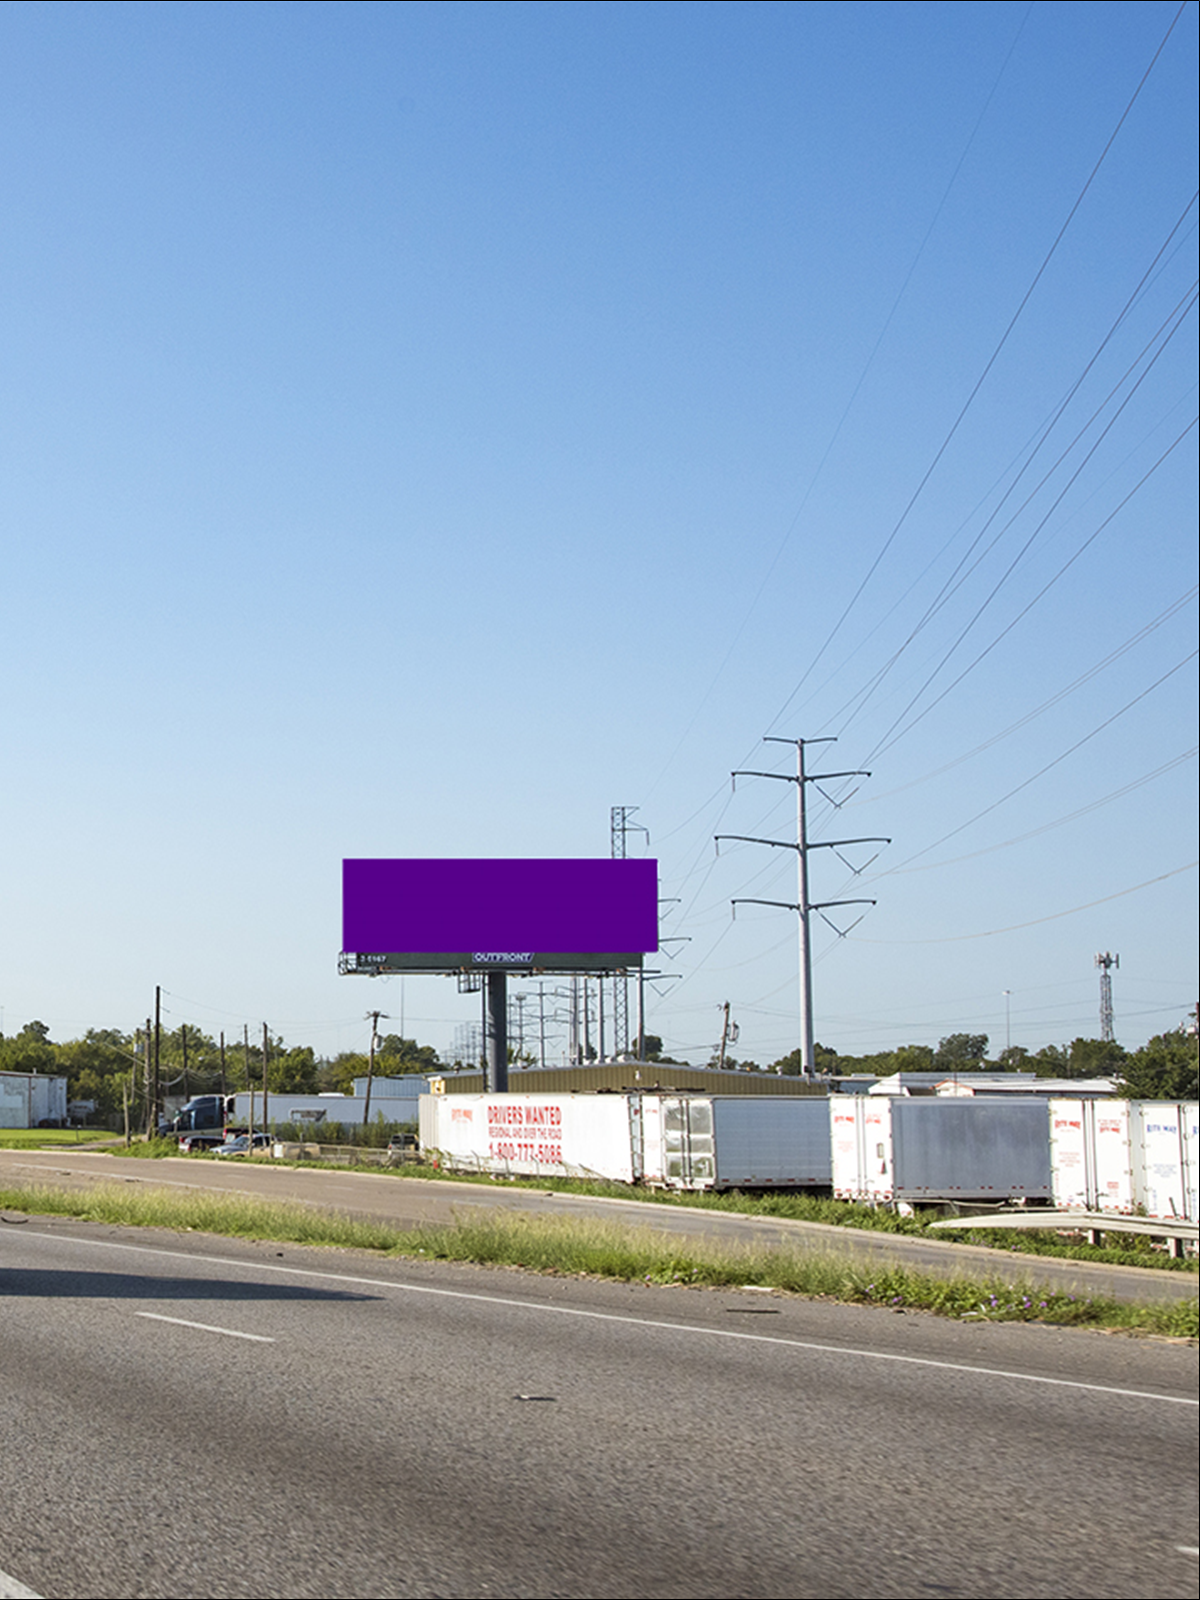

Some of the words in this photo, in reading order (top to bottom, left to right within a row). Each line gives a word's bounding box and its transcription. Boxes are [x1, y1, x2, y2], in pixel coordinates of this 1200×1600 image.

[474, 953, 532, 962] OUTFRONT
[487, 1105, 523, 1125] DRIVERS
[524, 1106, 562, 1126] WANTED
[488, 1126, 512, 1139] REGIONAL
[513, 1126, 523, 1139] AND
[523, 1127, 537, 1139] OVER
[537, 1127, 547, 1140] THE
[547, 1127, 562, 1141] ROAD
[488, 1141, 563, 1164] 1-800-777-5086
